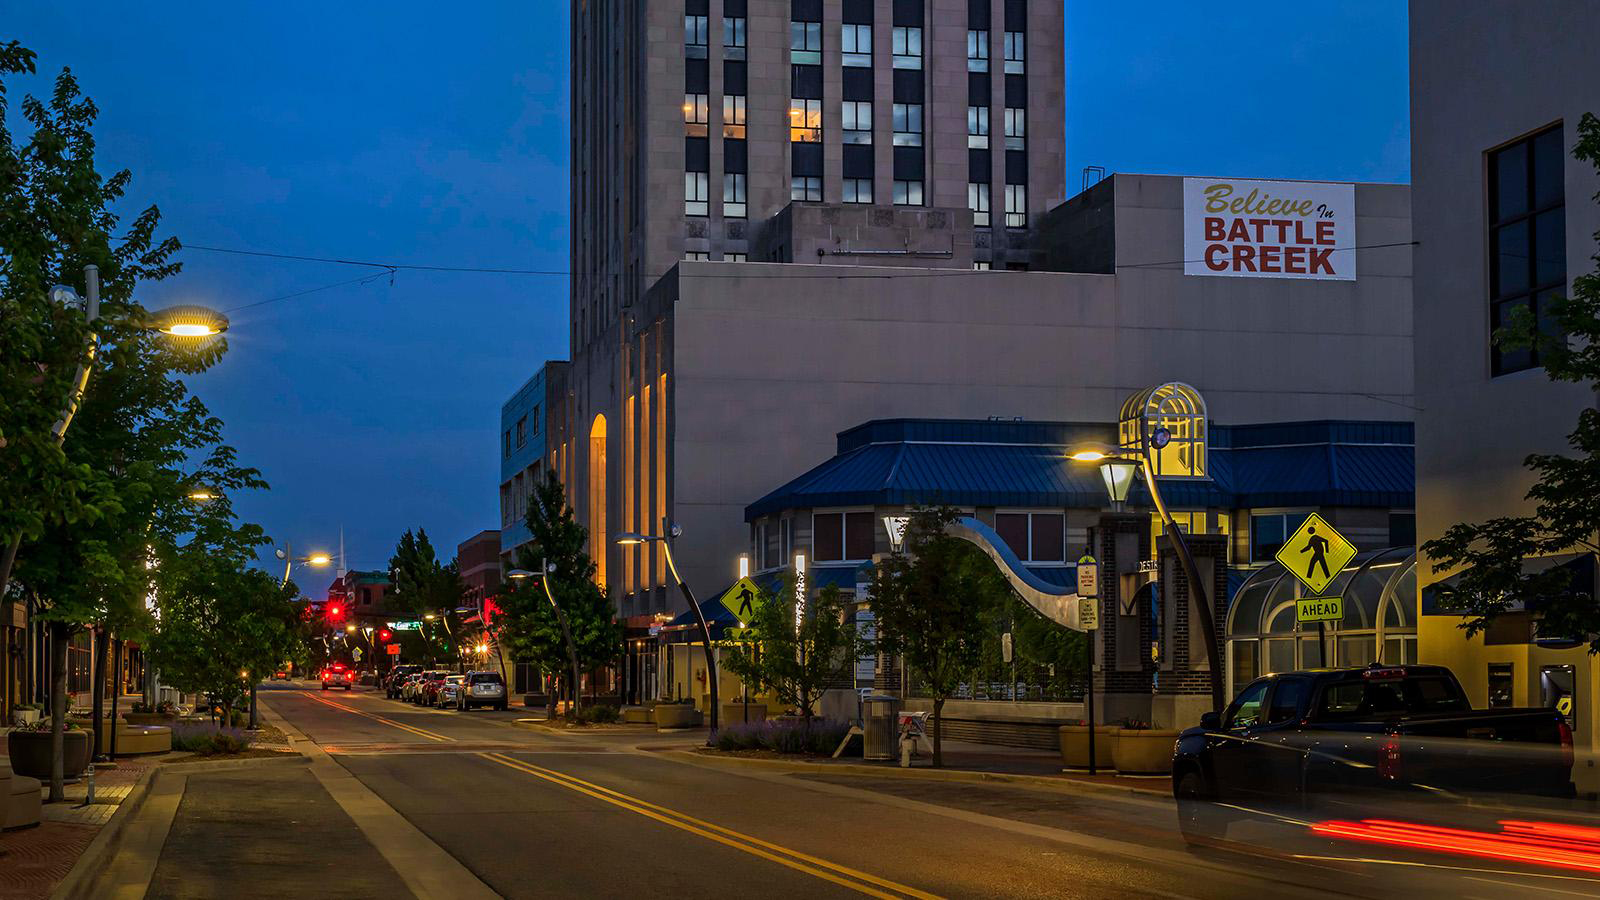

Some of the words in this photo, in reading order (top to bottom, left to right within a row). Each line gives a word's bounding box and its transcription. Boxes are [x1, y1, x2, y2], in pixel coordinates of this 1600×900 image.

[1203, 184, 1314, 216] Believe
[1316, 204, 1335, 219] In
[1204, 217, 1336, 245] BATTLE
[1204, 244, 1336, 275] CREEK
[1302, 602, 1338, 616] AHEAD
